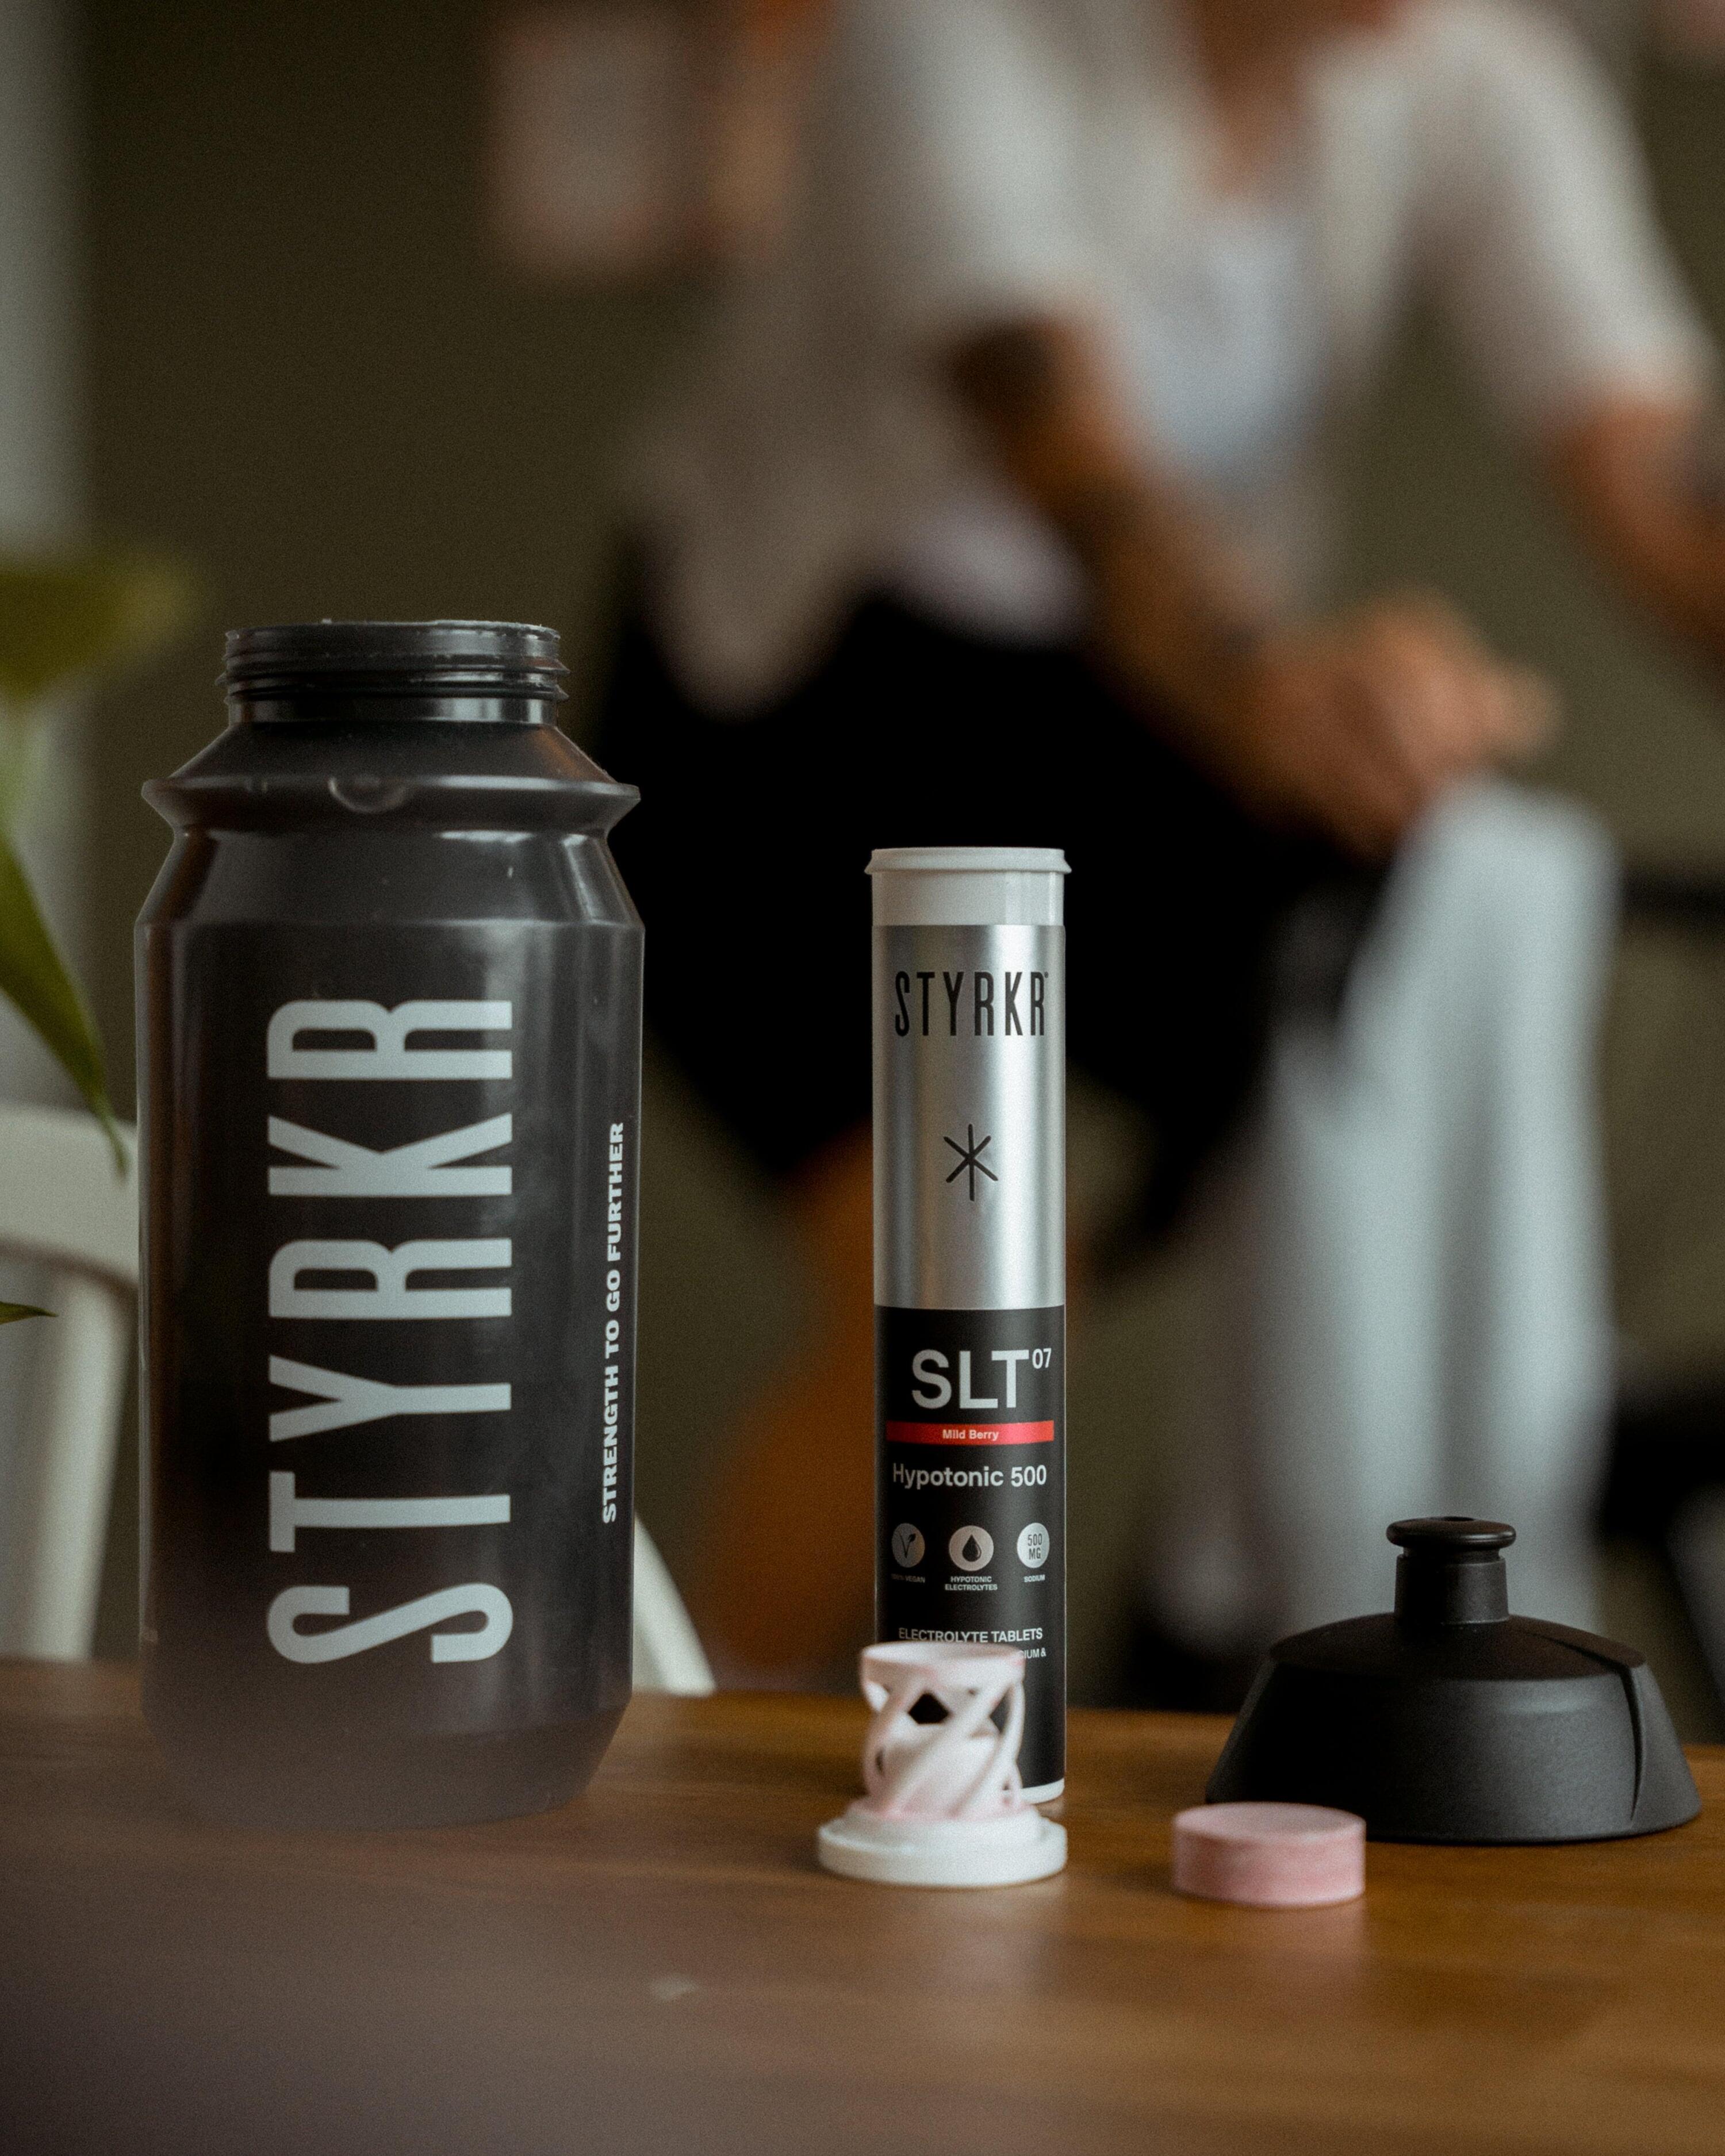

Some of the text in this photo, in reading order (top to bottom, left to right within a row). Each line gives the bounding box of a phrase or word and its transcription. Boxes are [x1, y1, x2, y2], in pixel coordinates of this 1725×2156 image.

[895, 970, 1045, 1037] STYRKR
[603, 1122, 623, 1524] STRENGTH TO GO FURTHER
[266, 999, 513, 1664] STYRKR
[911, 1348, 1052, 1409] SLT 07
[942, 1429, 999, 1441] Mild Berry
[893, 1463, 1047, 1490] Hypotonic 500
[1028, 1533, 1042, 1547] 500
[1029, 1548, 1041, 1560] MG
[1024, 1574, 1045, 1583] SODIUM
[899, 1628, 1043, 1643] ELECTROLYTE TABLETS
[1040, 1647, 1046, 1657] &
